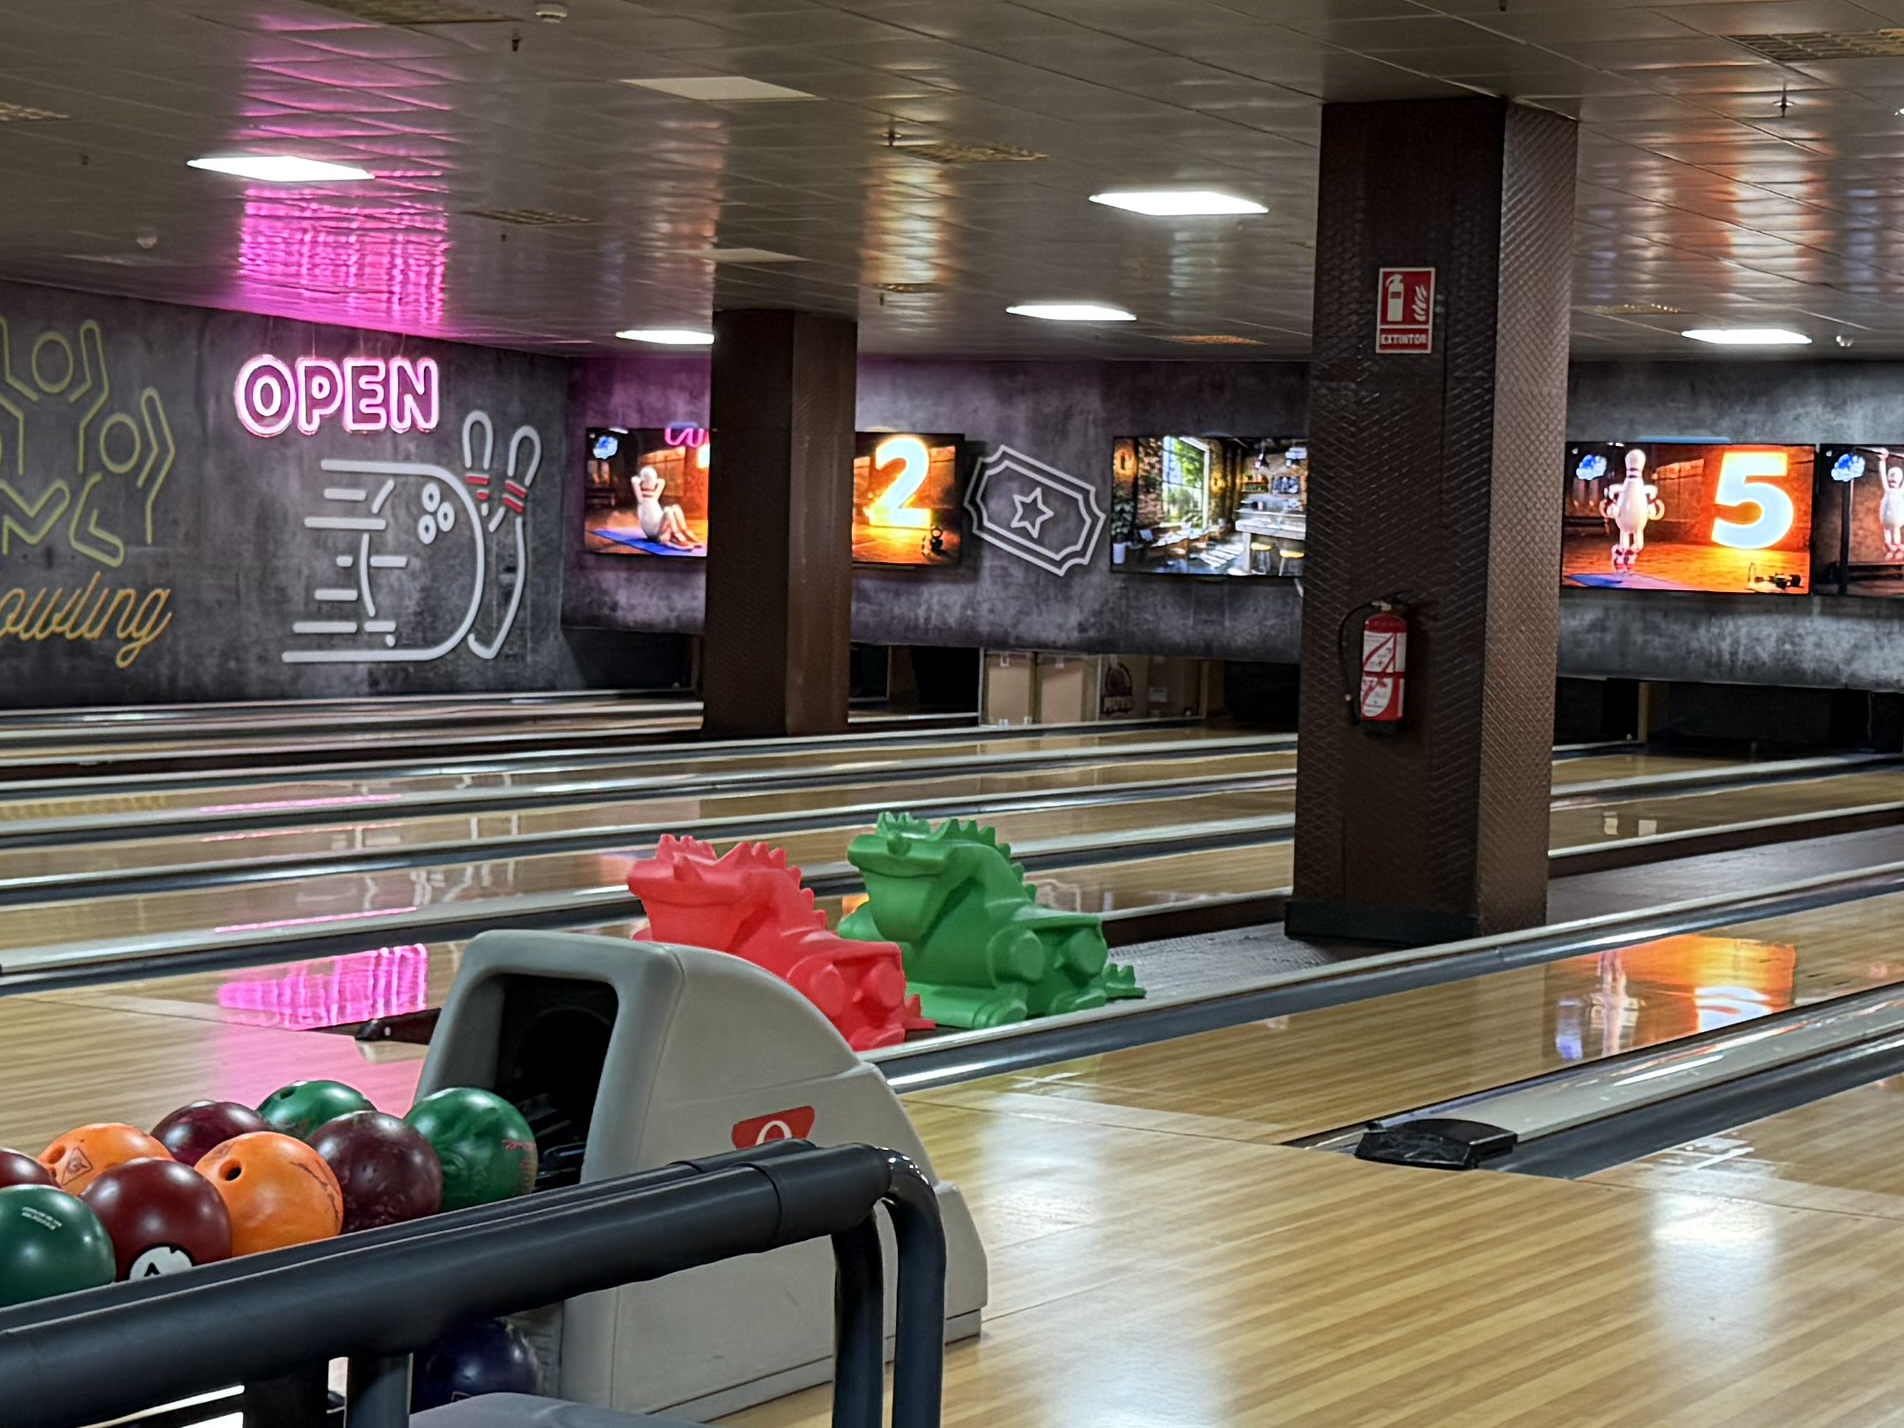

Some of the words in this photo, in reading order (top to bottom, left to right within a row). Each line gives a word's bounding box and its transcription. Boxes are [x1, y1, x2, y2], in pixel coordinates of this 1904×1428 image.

[234, 353, 440, 437] OPEN
[870, 433, 931, 529] 2
[1709, 450, 1796, 551] 5
